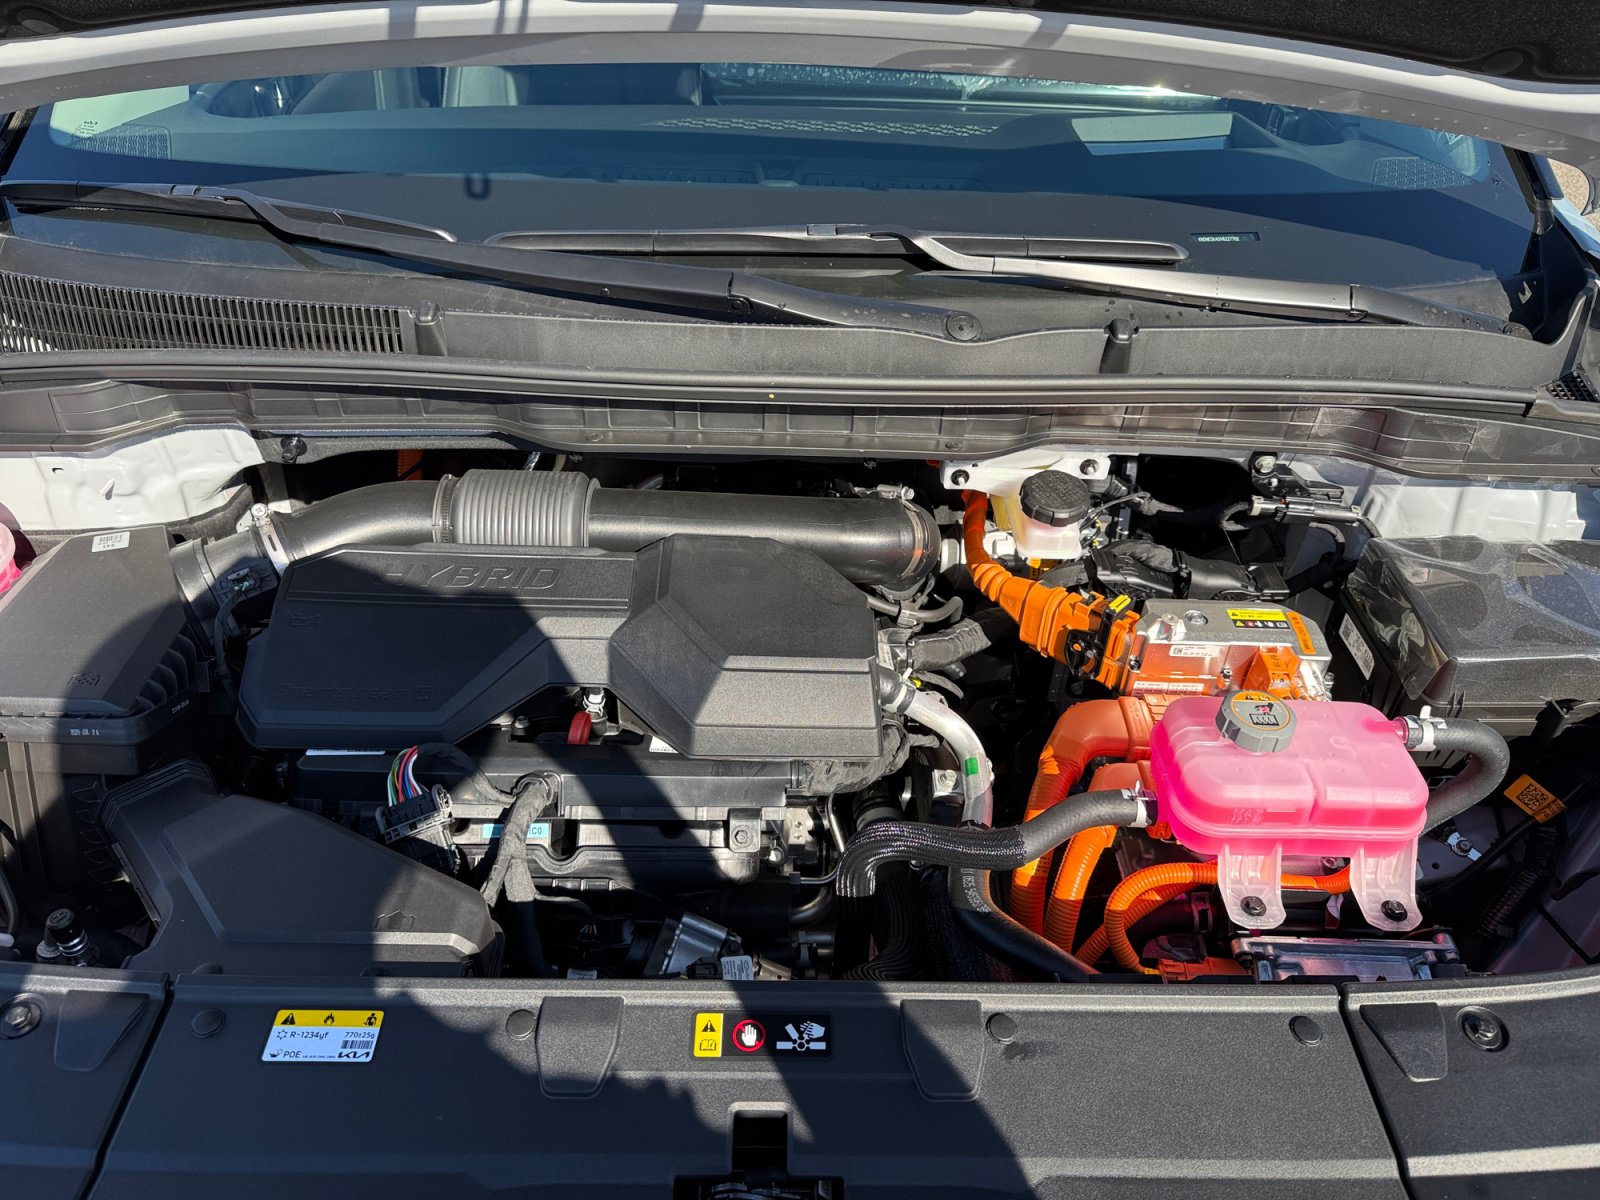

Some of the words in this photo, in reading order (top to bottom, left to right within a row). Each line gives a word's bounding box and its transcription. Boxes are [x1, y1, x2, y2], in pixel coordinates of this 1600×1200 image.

[376, 563, 560, 590] HYBRID
[289, 1031, 329, 1040] R-1234yf
[344, 1031, 376, 1040] 770±25g
[282, 1051, 302, 1059] POE
[337, 1051, 371, 1059] KIA
